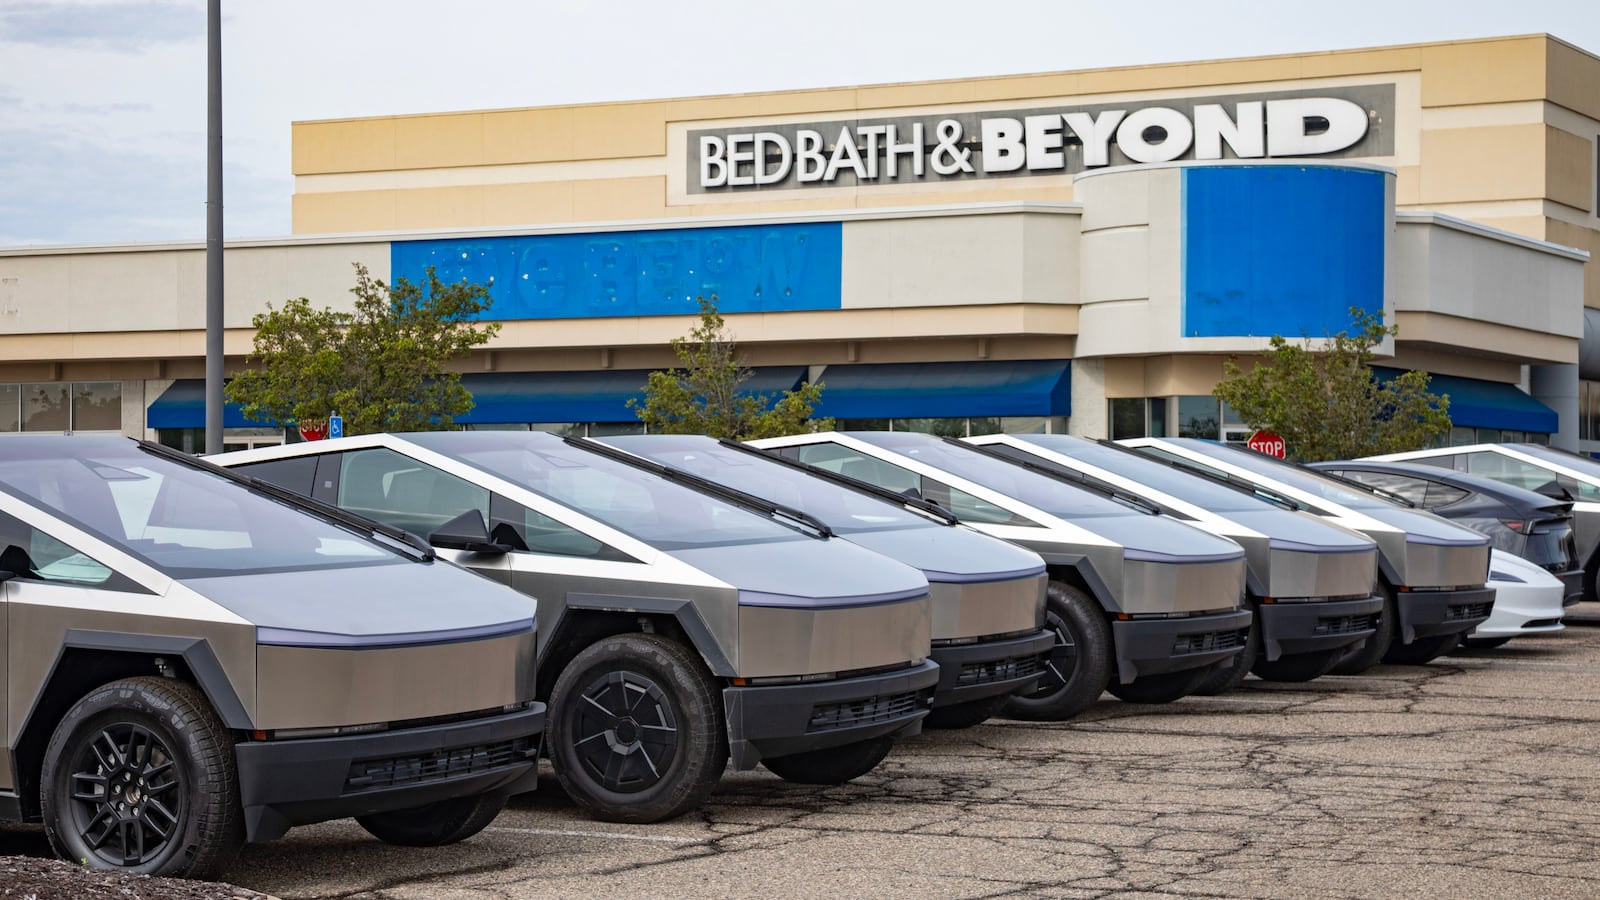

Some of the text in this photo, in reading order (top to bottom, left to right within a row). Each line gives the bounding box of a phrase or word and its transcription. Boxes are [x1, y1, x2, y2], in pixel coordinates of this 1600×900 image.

[700, 97, 1369, 187] BED BATH & BEYOND
